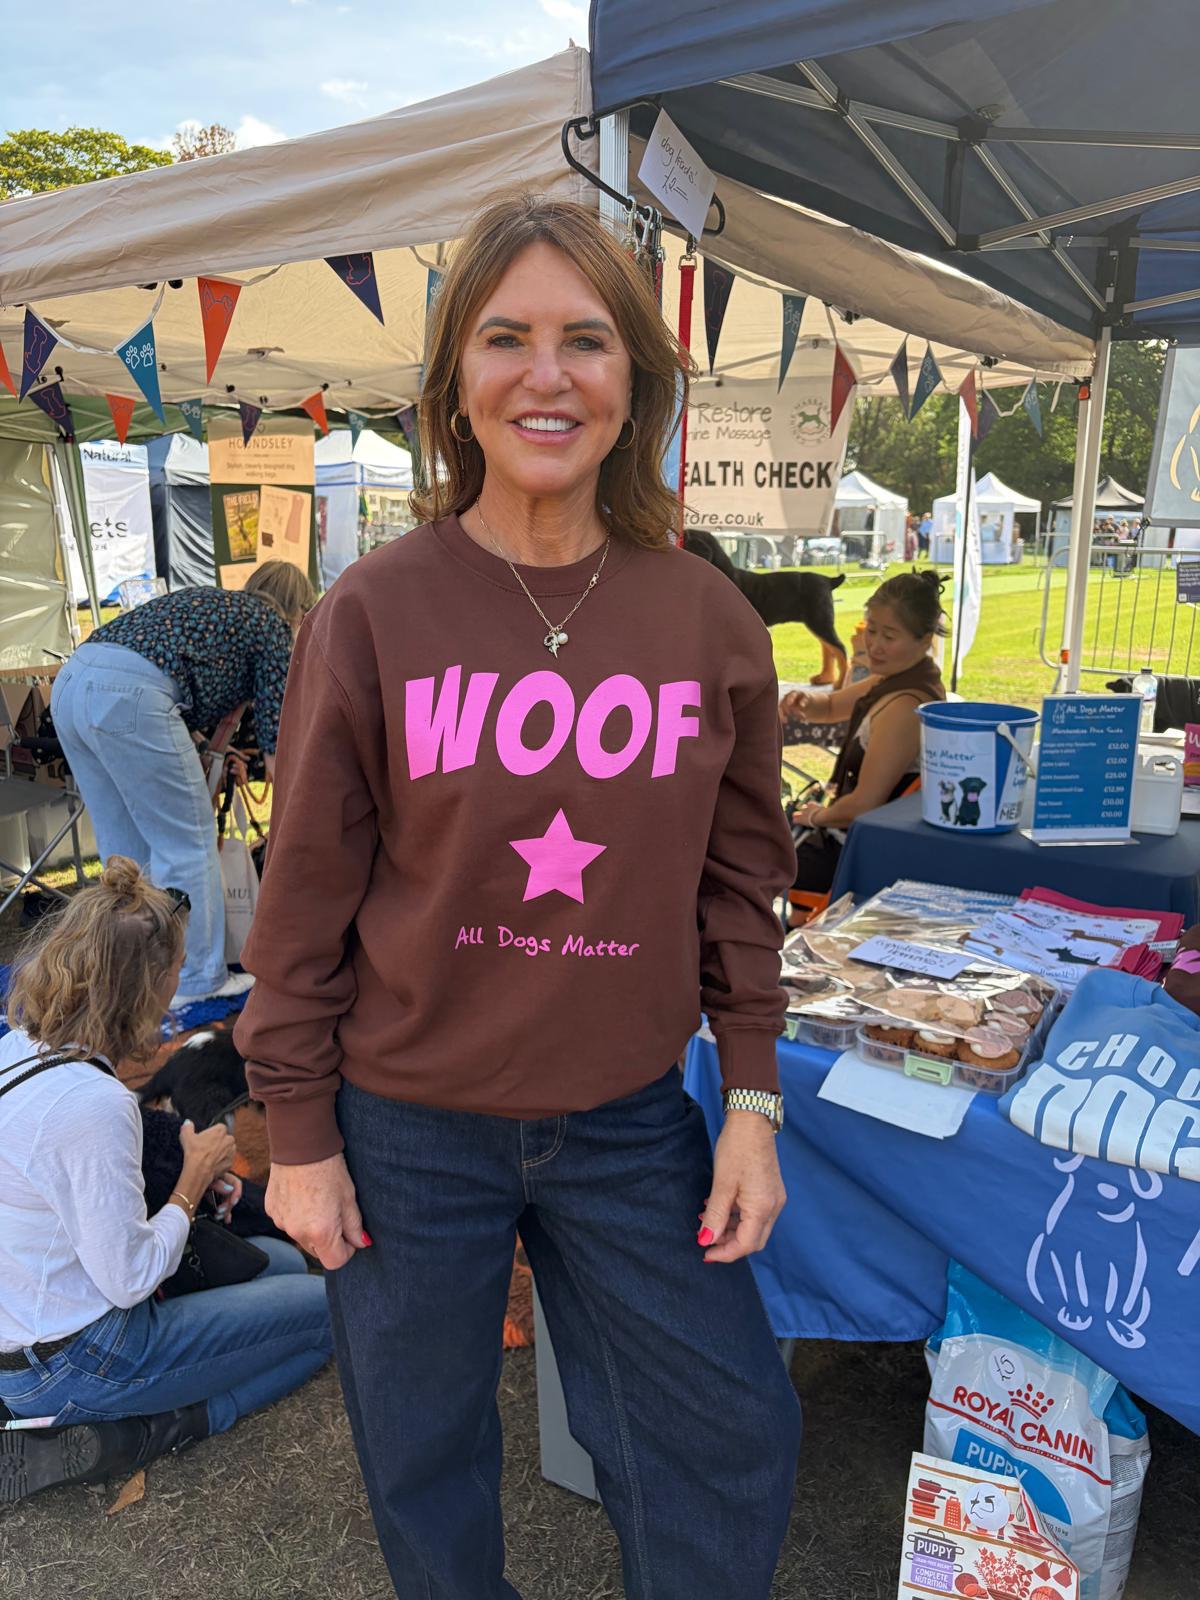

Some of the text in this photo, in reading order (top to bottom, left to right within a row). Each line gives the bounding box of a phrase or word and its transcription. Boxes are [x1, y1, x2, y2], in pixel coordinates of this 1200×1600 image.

[698, 401, 772, 424] Restore
[405, 665, 701, 781] WOOF
[455, 926, 640, 957] All Dogs Matter
[953, 1385, 1016, 1434] ROYAL
[1020, 1422, 1094, 1465] CANIN
[966, 1441, 1029, 1479] PUPPY
[917, 1539, 953, 1560] PUPPY
[914, 1575, 948, 1590] NUTRITION
[915, 1567, 949, 1583] COMPLETE
